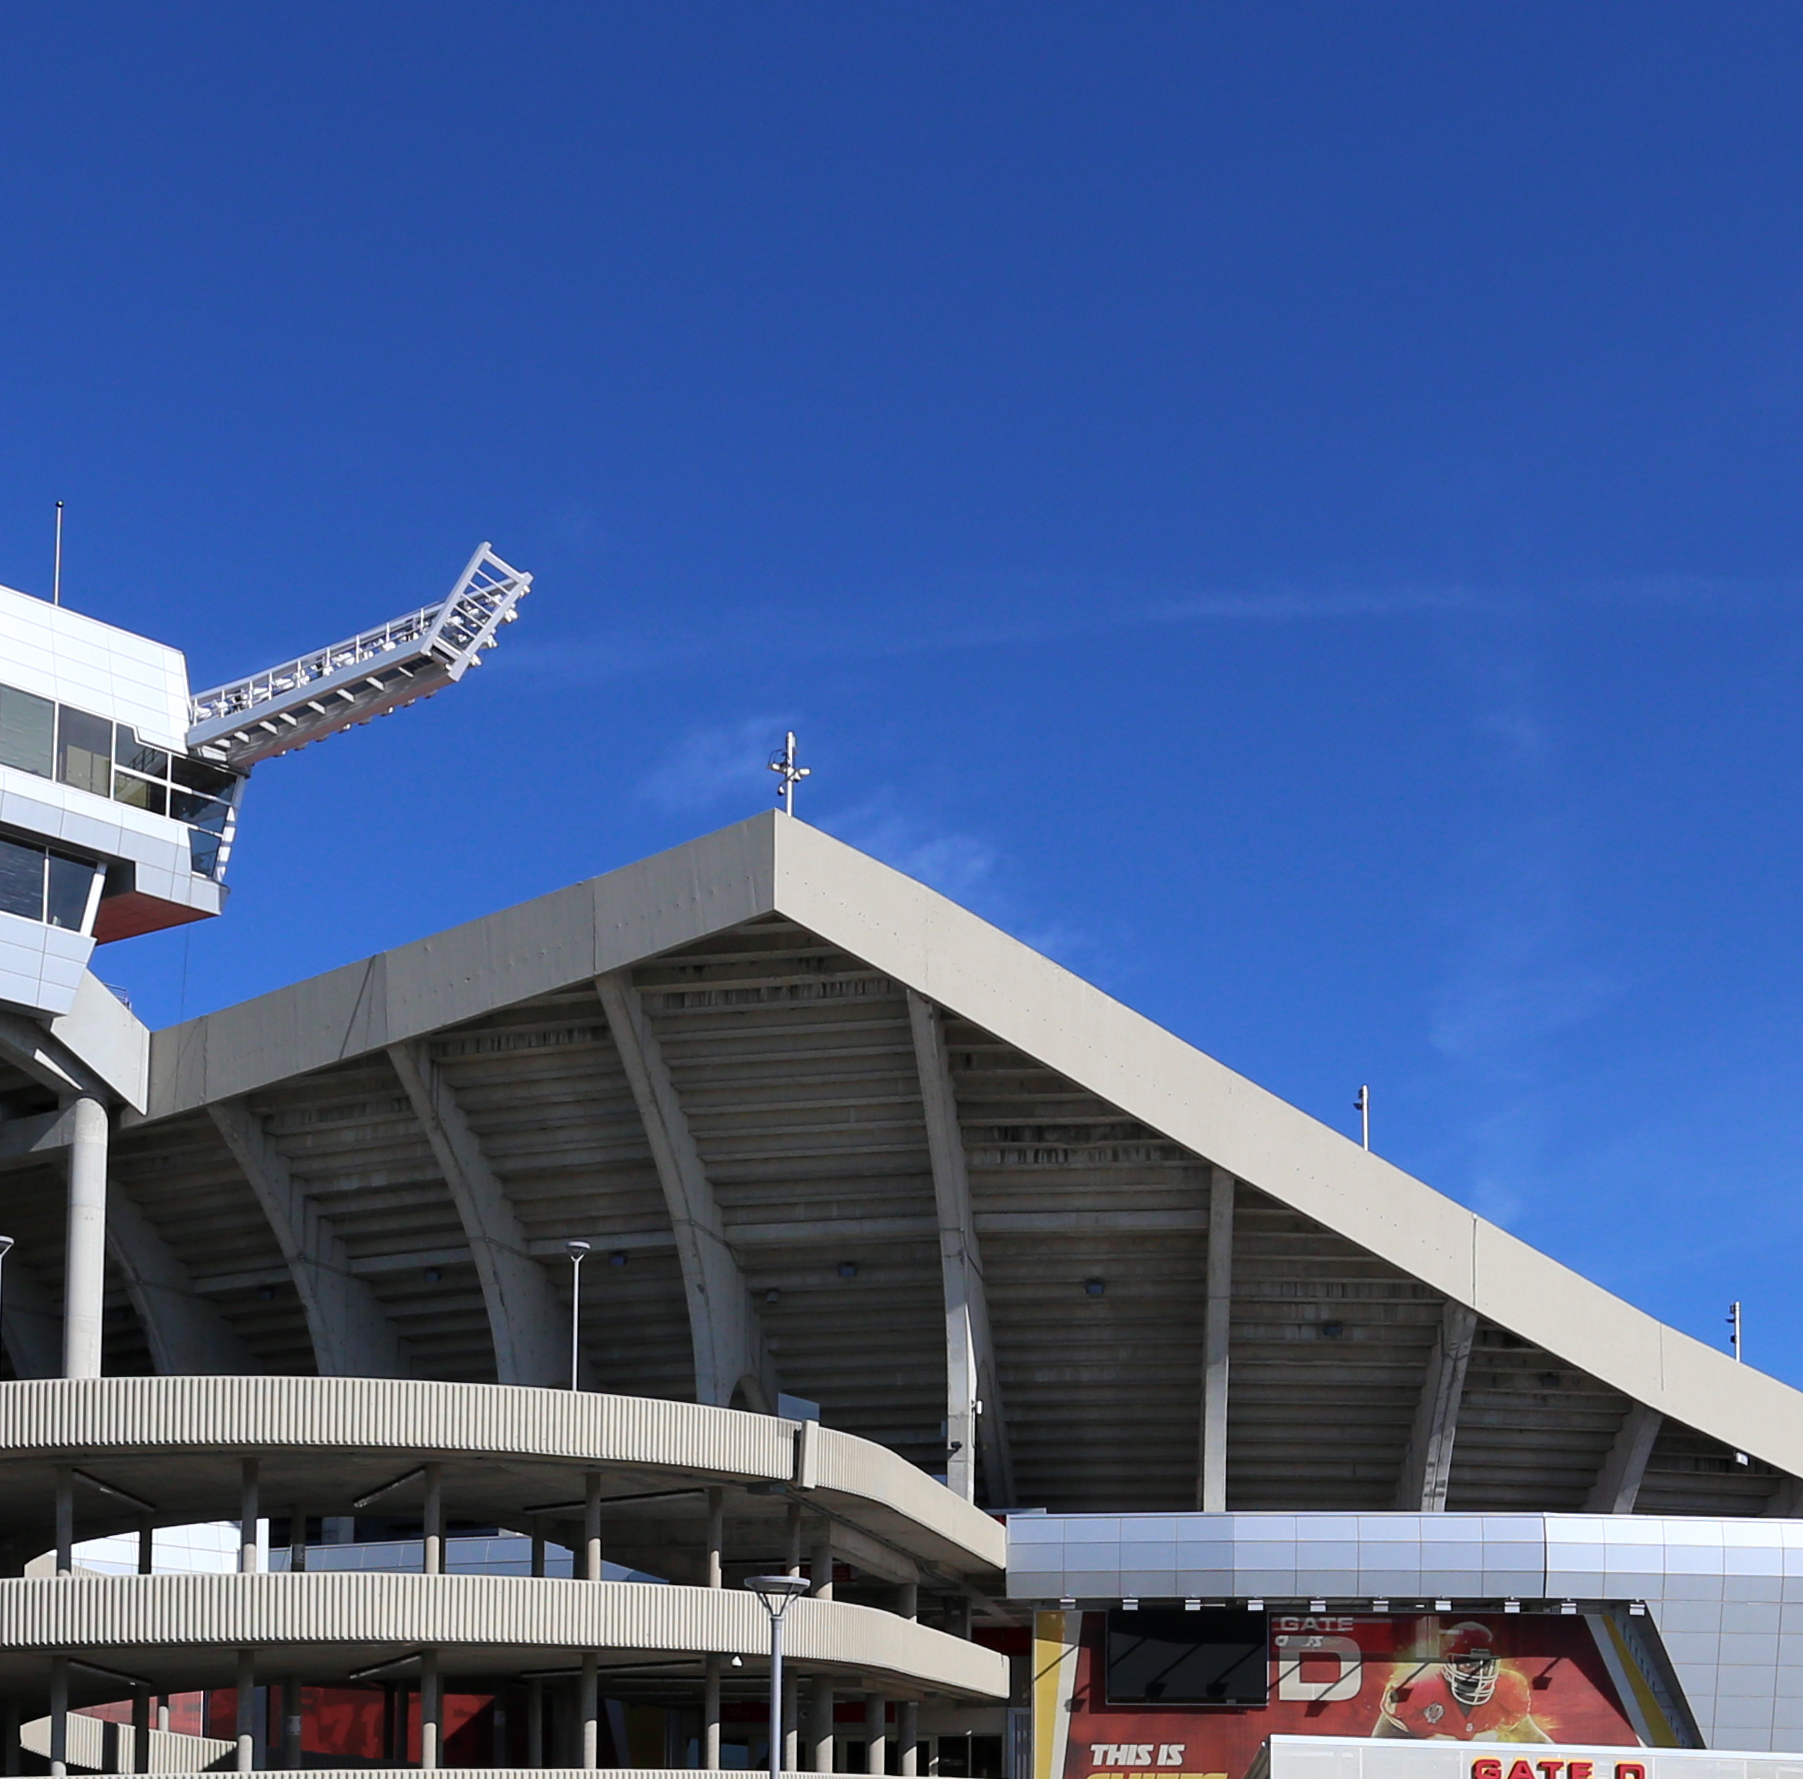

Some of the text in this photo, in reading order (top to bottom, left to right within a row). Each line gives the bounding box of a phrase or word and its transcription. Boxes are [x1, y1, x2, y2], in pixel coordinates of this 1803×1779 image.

[1279, 1616, 1354, 1632] GATE
[1278, 1635, 1362, 1702] D
[1090, 1744, 1186, 1766] THIS IS
